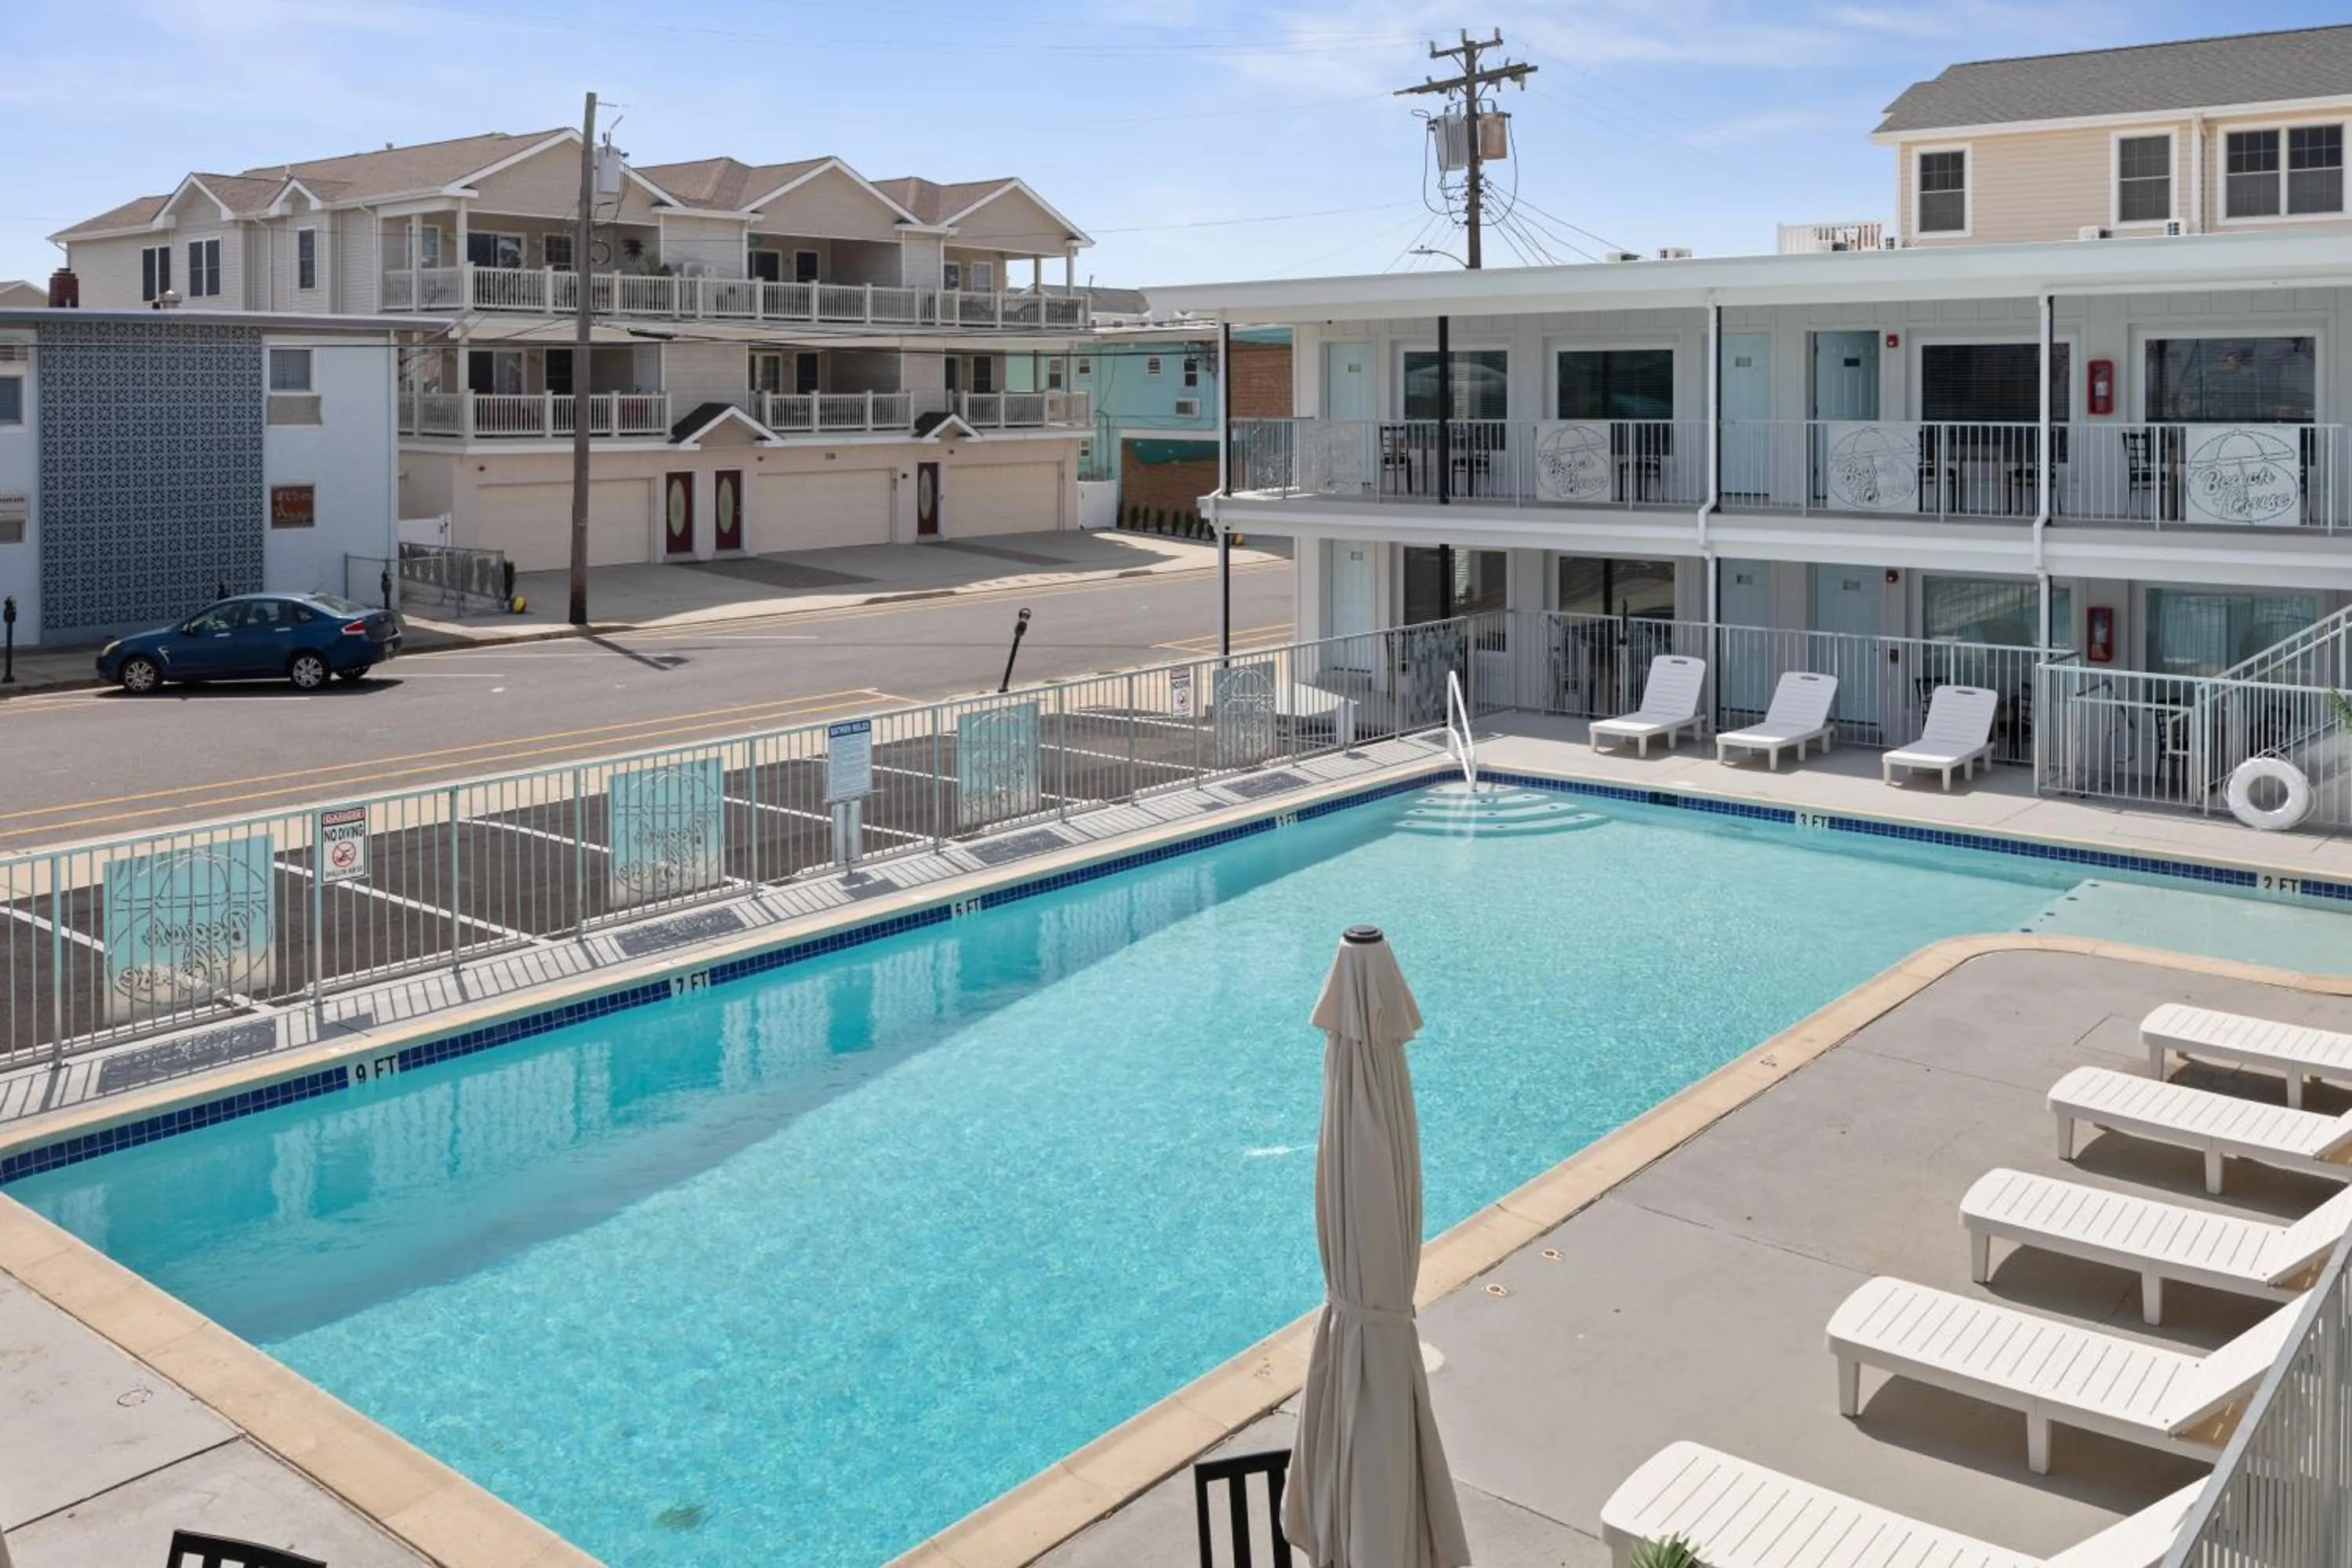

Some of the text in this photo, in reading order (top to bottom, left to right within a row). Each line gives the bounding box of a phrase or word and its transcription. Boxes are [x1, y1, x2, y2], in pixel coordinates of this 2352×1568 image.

[2200, 466, 2276, 495] Beach
[1812, 815, 1828, 828] FT
[325, 823, 363, 843] NO DIVING
[2279, 877, 2299, 892] FT
[966, 898, 979, 914] FT
[676, 971, 707, 995] 7 FT
[356, 1054, 396, 1083] 9 FT
